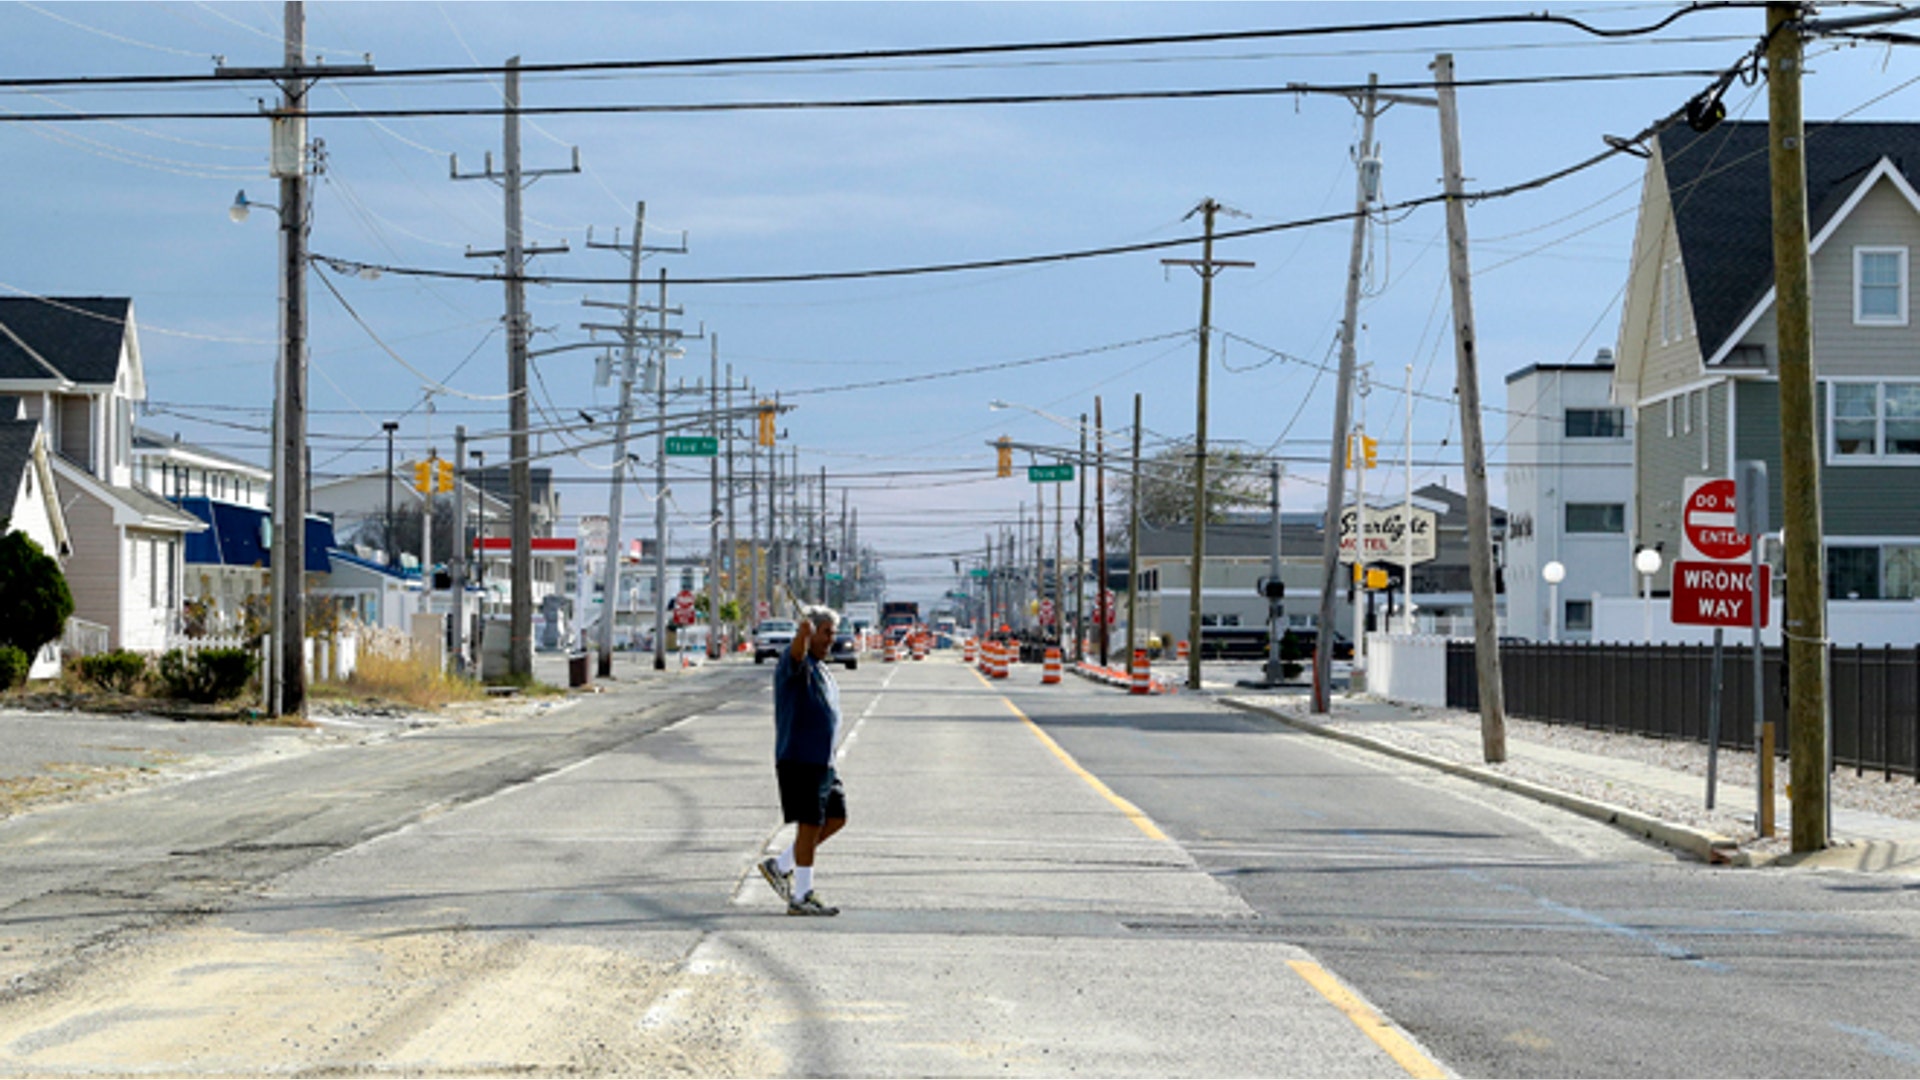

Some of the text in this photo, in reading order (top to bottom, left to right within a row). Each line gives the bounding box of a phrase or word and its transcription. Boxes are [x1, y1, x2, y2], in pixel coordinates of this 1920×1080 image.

[1695, 494, 1718, 508] DO
[1699, 529, 1747, 546] ENTER
[1698, 597, 1744, 619] WAY
